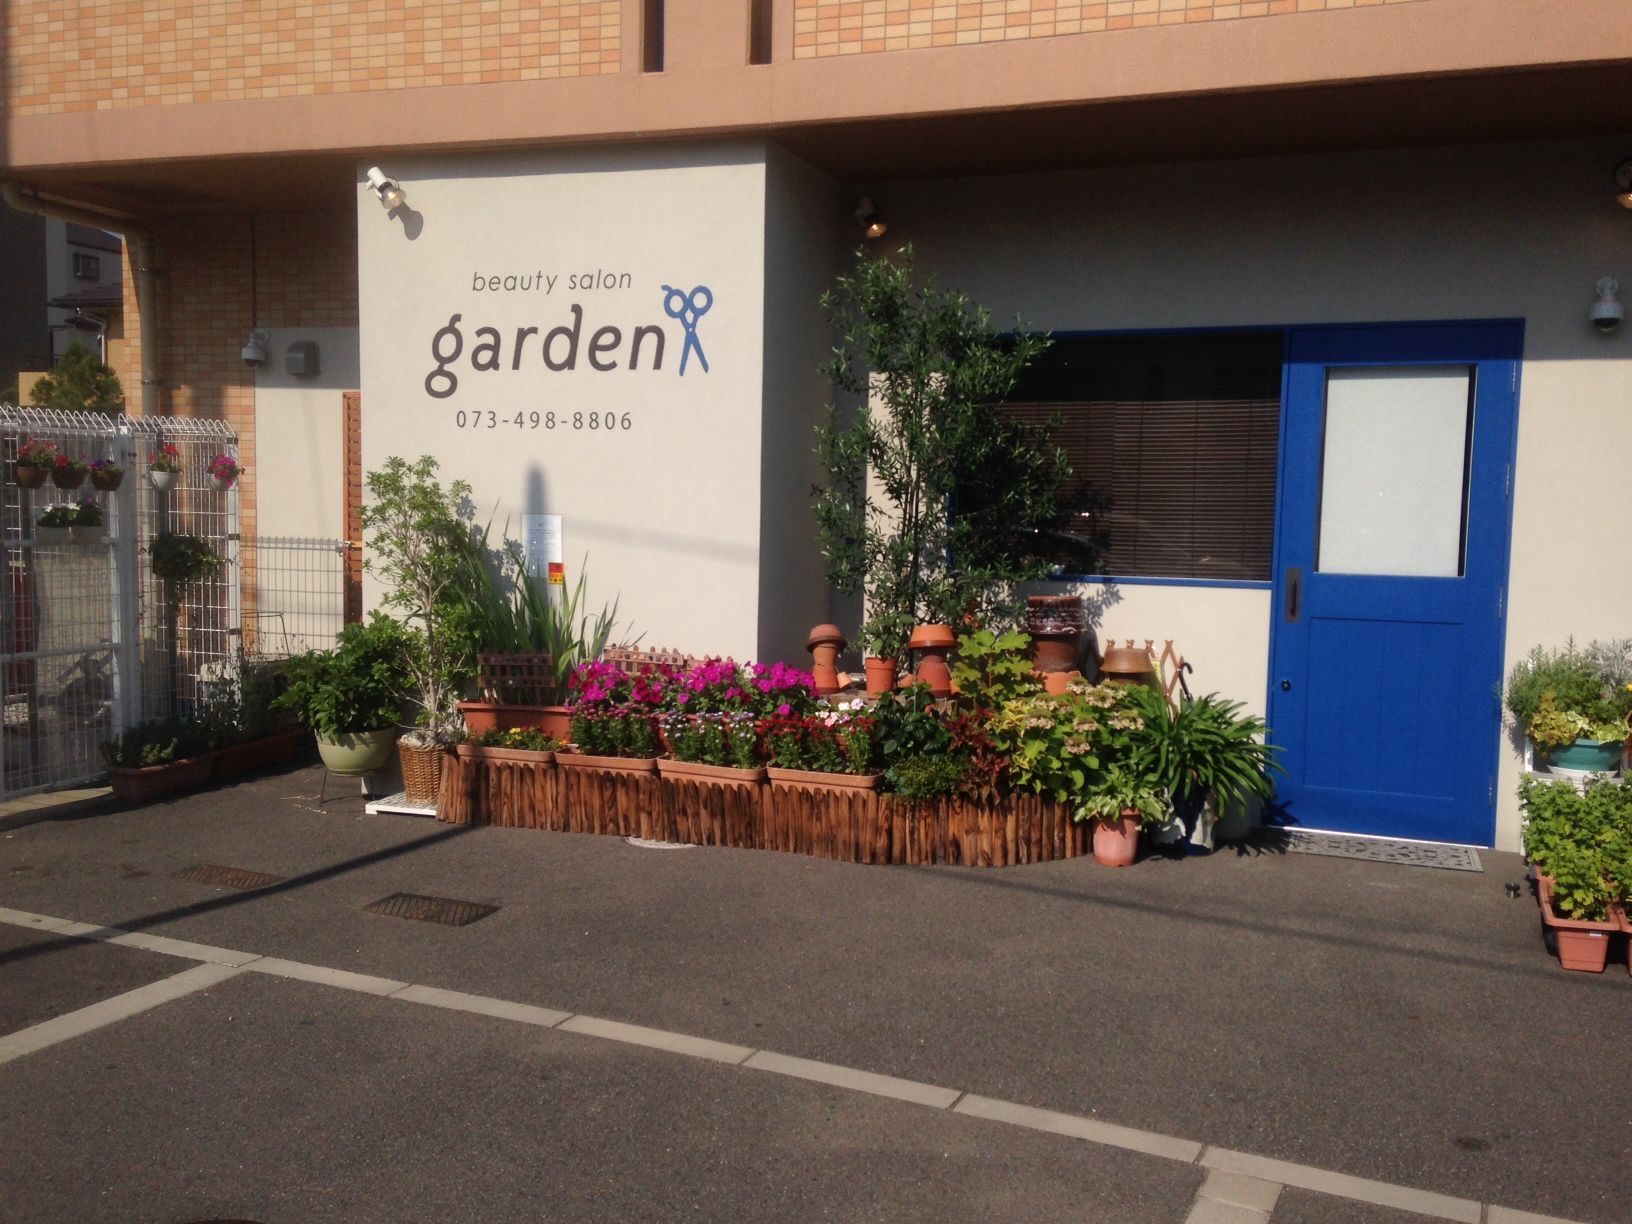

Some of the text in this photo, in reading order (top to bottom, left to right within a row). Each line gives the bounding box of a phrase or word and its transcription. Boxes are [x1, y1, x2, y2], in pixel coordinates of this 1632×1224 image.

[472, 268, 632, 295] beauty salon
[424, 303, 666, 399] garden
[456, 410, 632, 431] 073-498-8806
